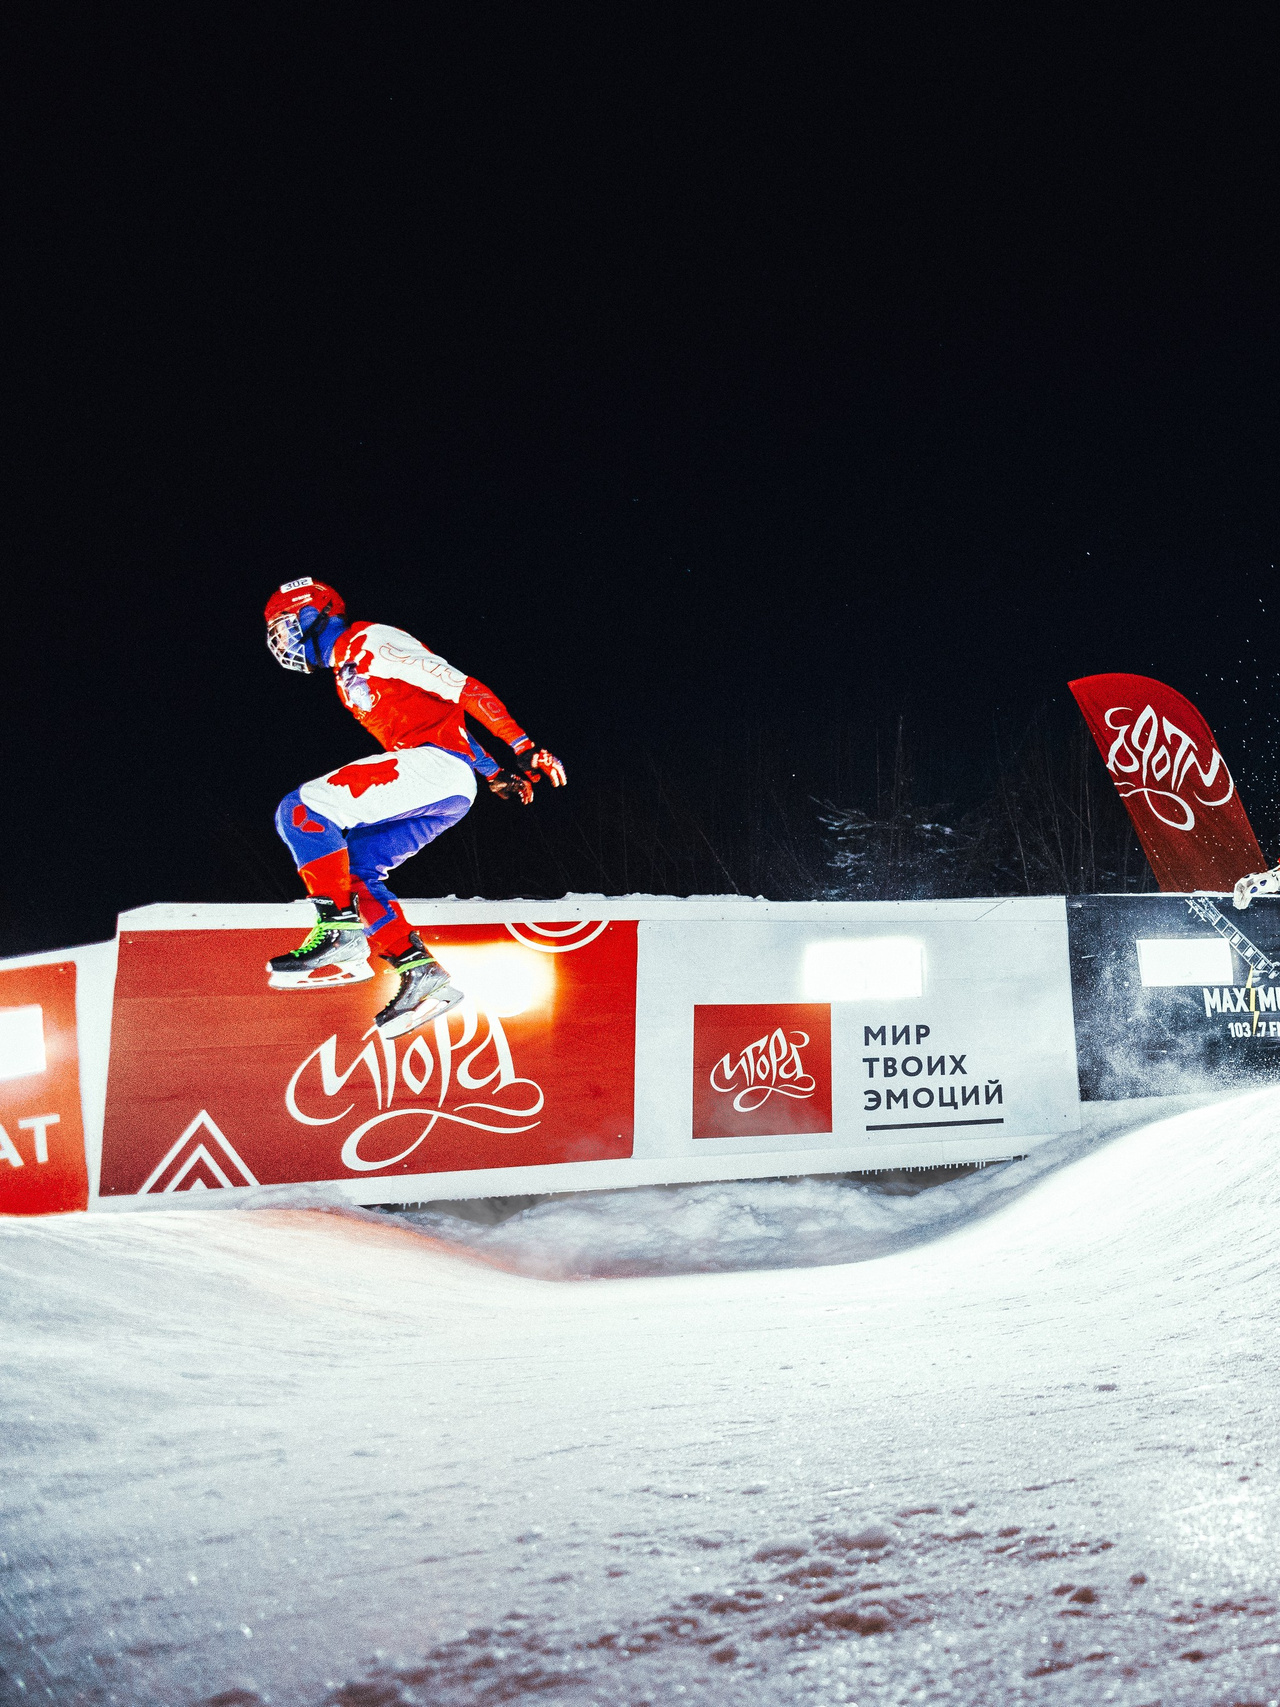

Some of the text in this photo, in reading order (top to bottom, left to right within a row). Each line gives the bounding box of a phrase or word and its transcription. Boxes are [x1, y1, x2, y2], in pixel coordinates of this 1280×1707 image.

[863, 1024, 931, 1046] МИР
[1227, 1021, 1267, 1038] 103.7
[862, 1054, 968, 1079] ТВОИХ
[862, 1079, 1004, 1111] ЭМОЦИЙ
